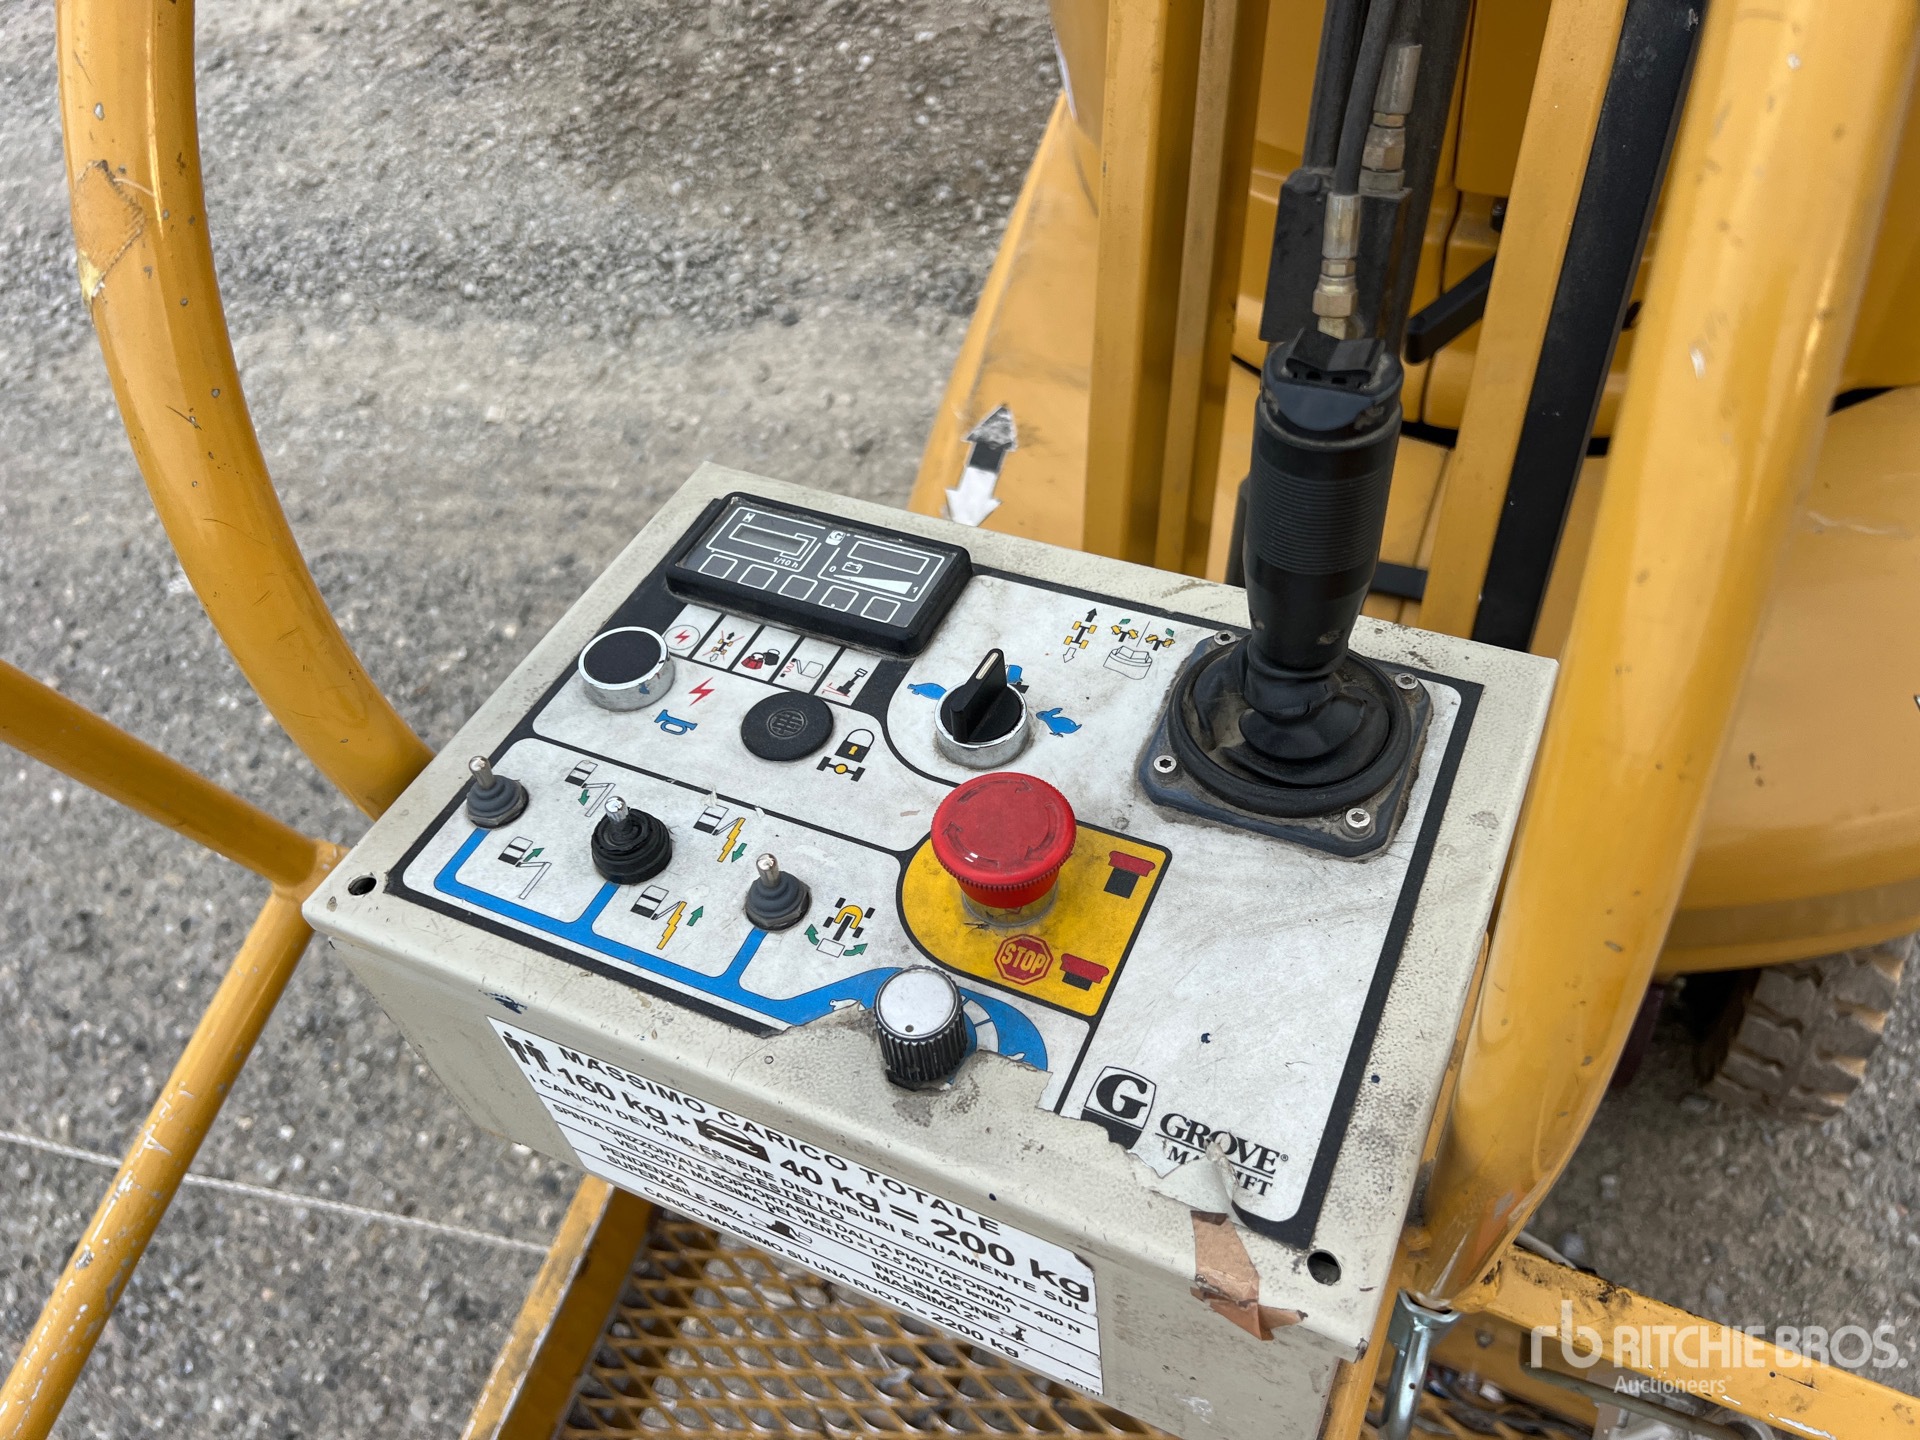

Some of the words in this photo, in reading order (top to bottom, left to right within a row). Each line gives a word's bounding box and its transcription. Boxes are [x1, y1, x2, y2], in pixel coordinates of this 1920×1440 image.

[773, 556, 792, 568] 1/10
[791, 561, 799, 569] h
[1001, 943, 1047, 974] STOP
[1096, 1074, 1148, 1119] G
[559, 1046, 706, 1114] MASSIMO
[718, 1111, 848, 1170] CARICO
[860, 1167, 1001, 1236] TOTALE
[599, 1143, 688, 1186] PENDENZA
[540, 1079, 612, 1114] CARICHI
[617, 1111, 694, 1147] DEVONO
[698, 1143, 777, 1182] ESSERE
[781, 1178, 896, 1232] DISTRIBURI
[902, 1229, 1036, 1293] EQUAMENTE
[1043, 1290, 1087, 1314] SUL
[558, 1068, 616, 1101] 160
[622, 1092, 668, 1125] kg
[780, 1159, 823, 1186] 40
[831, 1177, 881, 1213] kg
[930, 1219, 1015, 1266] 200
[1030, 1258, 1090, 1303] kg
[606, 1154, 709, 1201] SUPERABILE
[743, 1172, 844, 1220] CESTELLO
[553, 1104, 604, 1130] SPINTA
[603, 1127, 708, 1173] ORIZZONTALE
[711, 1170, 833, 1227] SOPPORTABILE
[836, 1223, 894, 1252] DALLA
[896, 1248, 1016, 1307] PIATTAFORMA
[1034, 1310, 1067, 1327] 400
[1068, 1323, 1081, 1334] N
[691, 1169, 762, 1205] MASSIMA
[764, 1201, 797, 1220] DEL
[800, 1216, 853, 1244] VENTO
[905, 1262, 934, 1280] m/s
[938, 1276, 962, 1293] (45
[964, 1287, 1011, 1314] km/h)
[644, 1187, 704, 1217] CARICO
[708, 1214, 783, 1252] MASSIMO
[786, 1250, 810, 1264] SU
[813, 1261, 853, 1283] UNA
[852, 1278, 916, 1310] RUOTA
[931, 1313, 985, 1341] 2200
[990, 1337, 1019, 1359] kg
[871, 1261, 1001, 1321] INCLINAZIONE
[875, 1272, 965, 1318] MASSIMA
